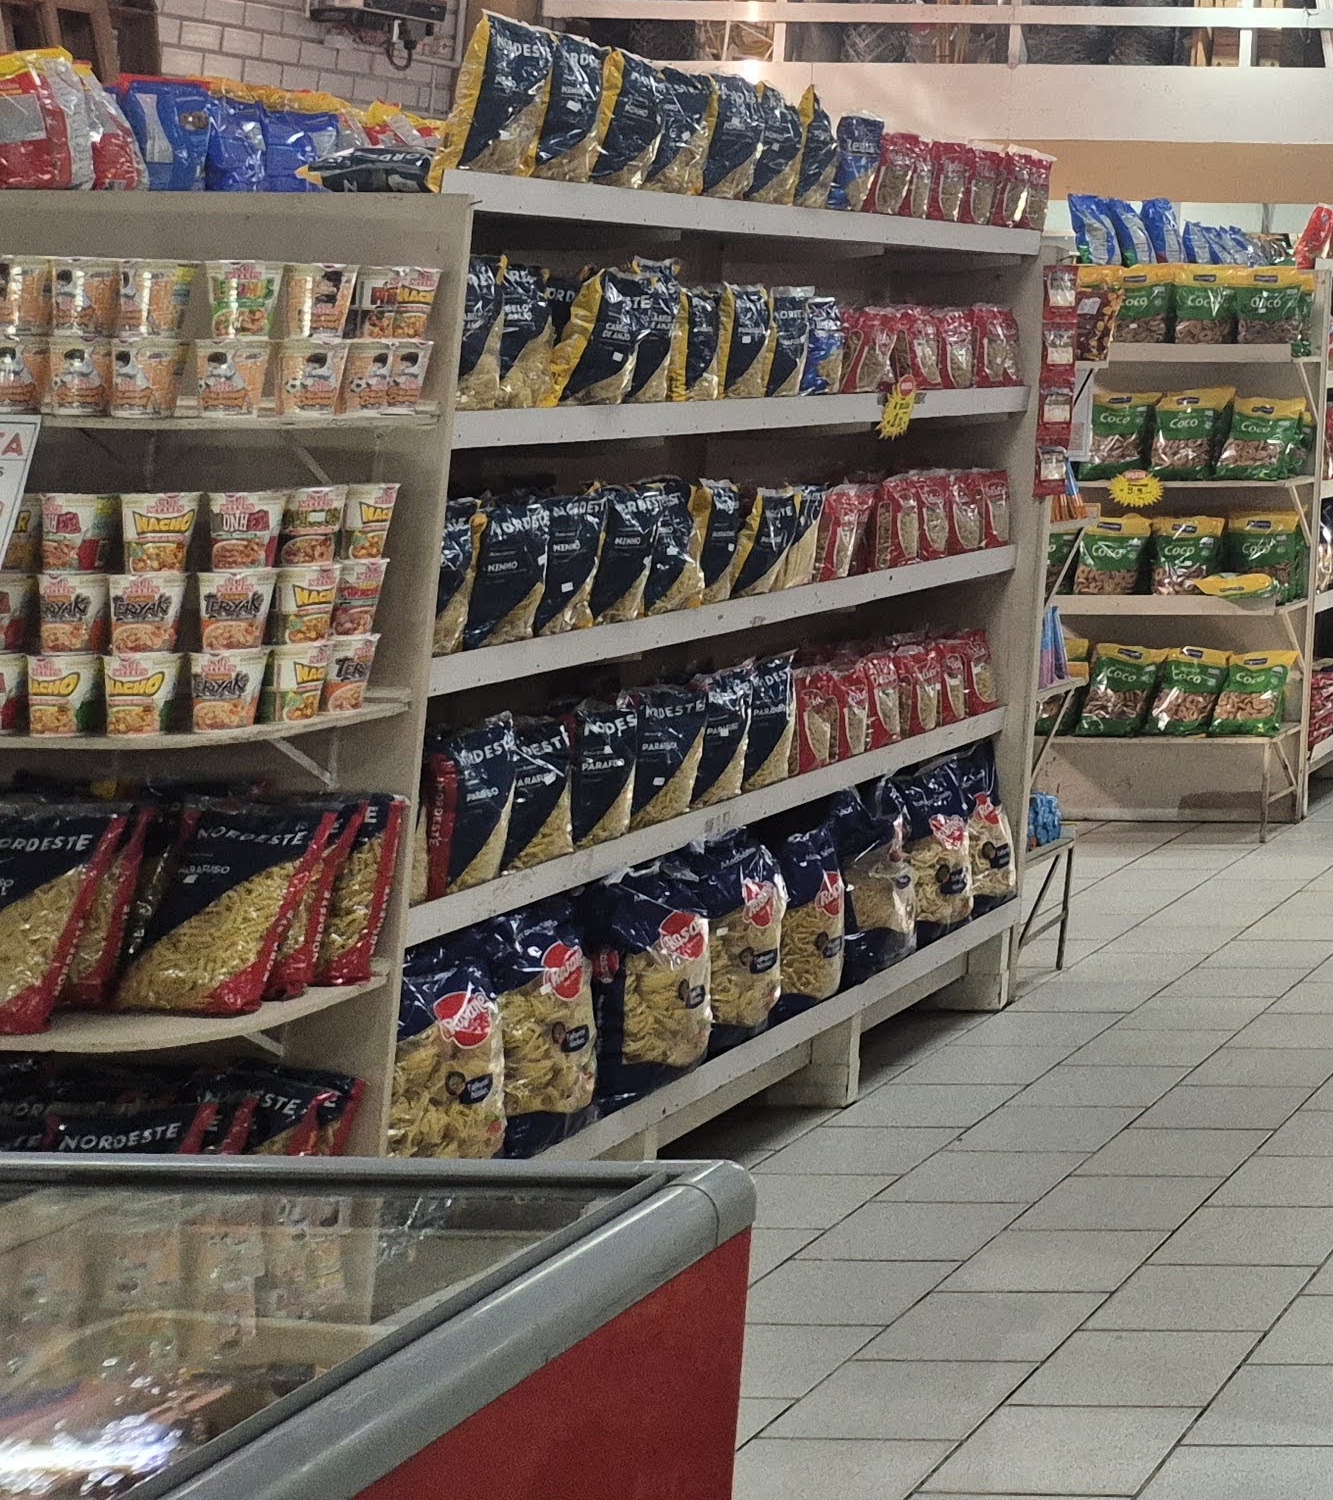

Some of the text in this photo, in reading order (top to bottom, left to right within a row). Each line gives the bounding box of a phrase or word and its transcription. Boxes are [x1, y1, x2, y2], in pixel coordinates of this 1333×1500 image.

[1099, 412, 1131, 425] Coco
[1169, 417, 1199, 429] Coco
[1240, 421, 1271, 433] Coco
[136, 510, 191, 534] NACHO
[1164, 544, 1195, 556] Coco
[1106, 666, 1137, 682] Coco
[1235, 673, 1266, 684] Coco
[198, 825, 305, 847] NORDESTE
[664, 915, 702, 952] Rosa
[58, 1122, 182, 1151] NORDESTE
